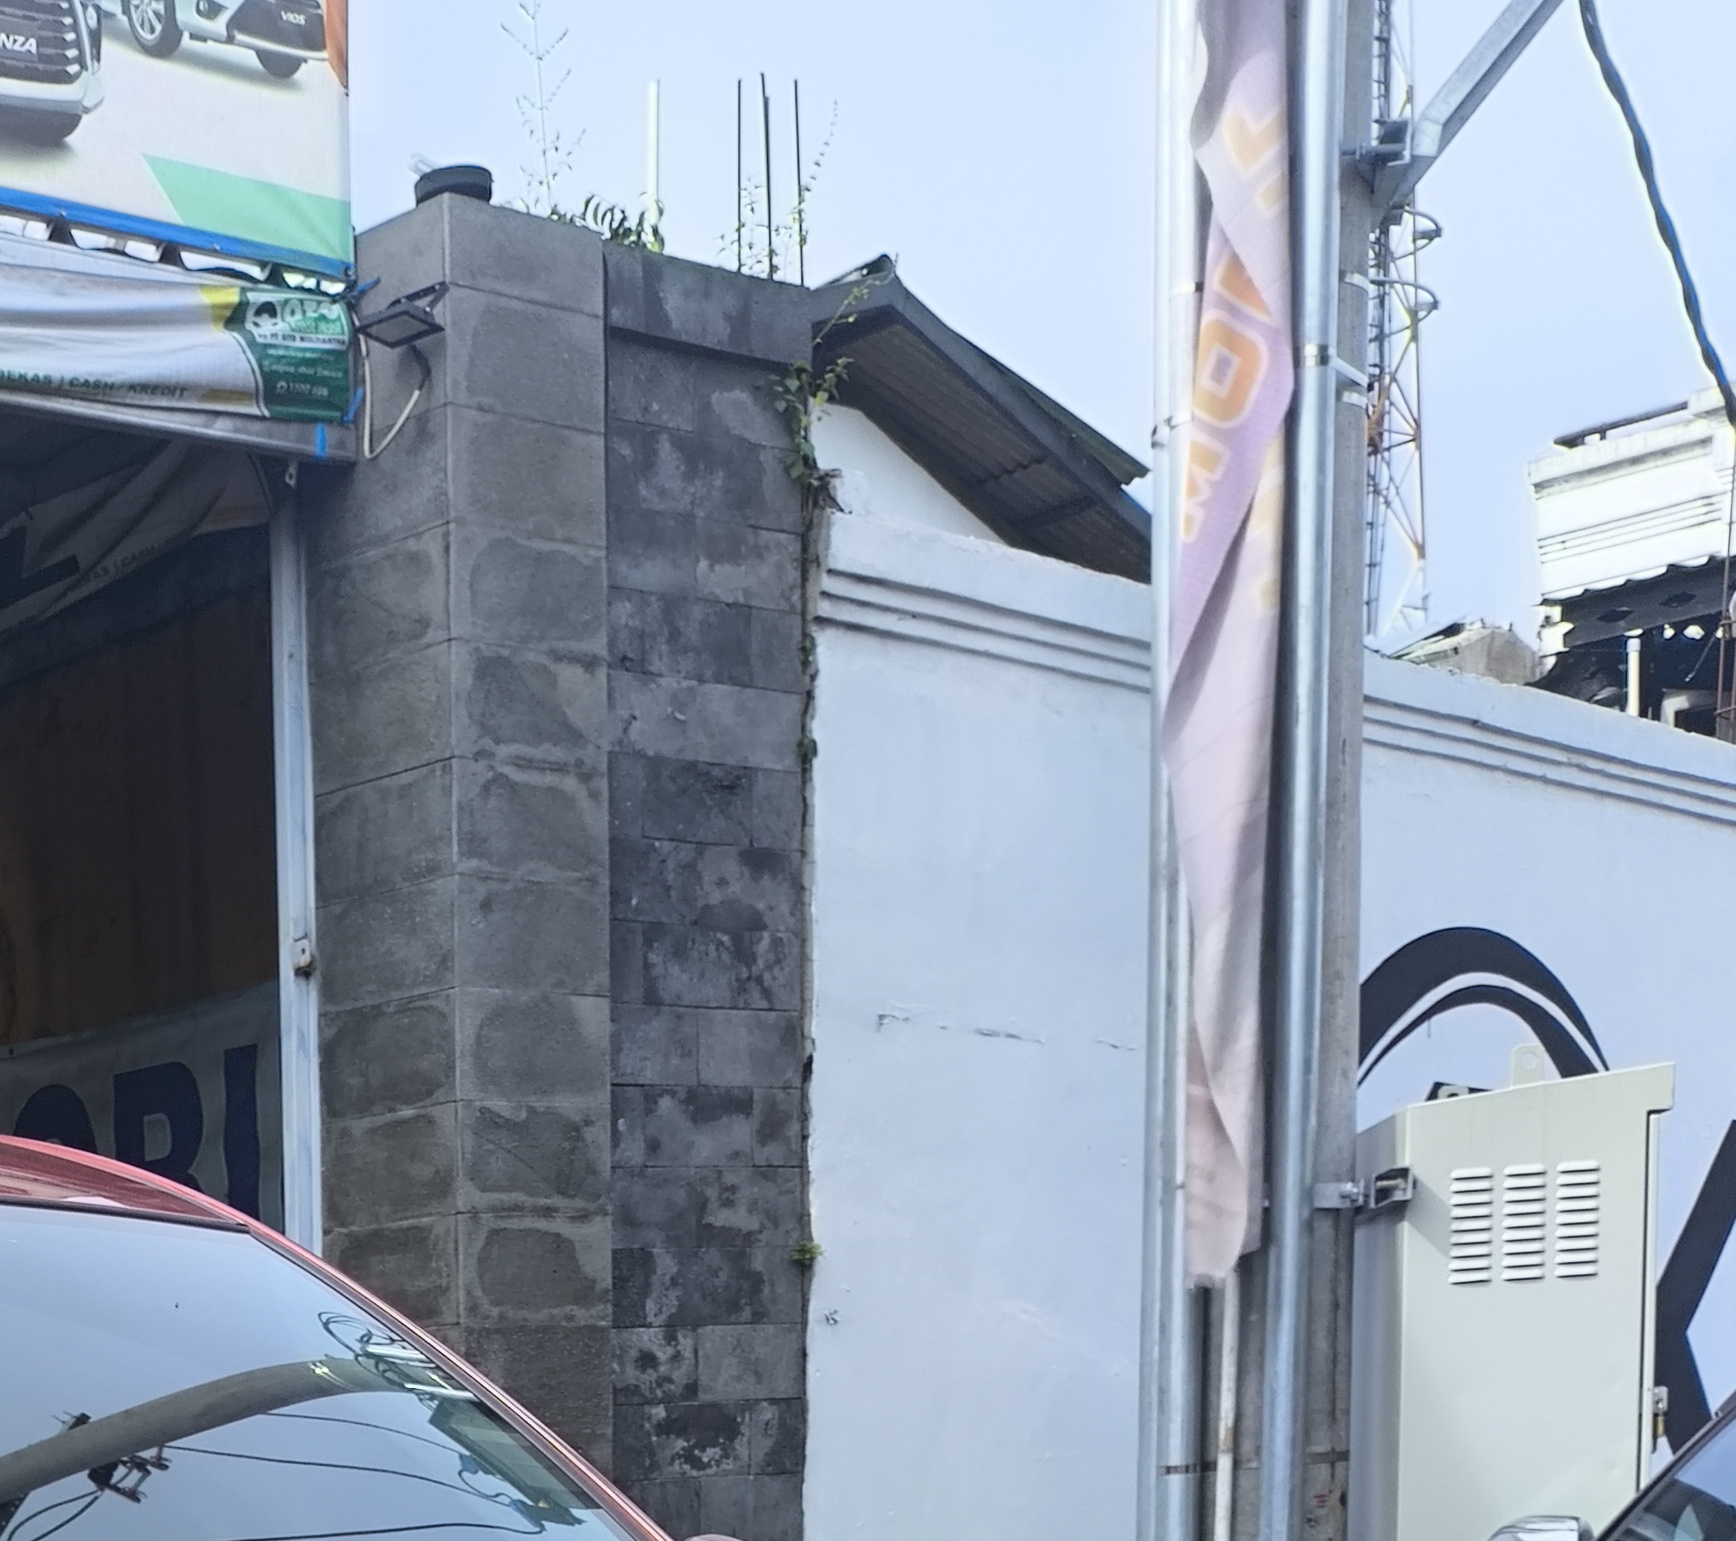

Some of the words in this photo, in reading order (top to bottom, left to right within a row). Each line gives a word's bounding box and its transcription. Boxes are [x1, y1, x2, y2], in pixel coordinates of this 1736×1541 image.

[280, 10, 306, 25] VIOS
[70, 376, 116, 393] CASH
[128, 383, 188, 399] KREDIT
